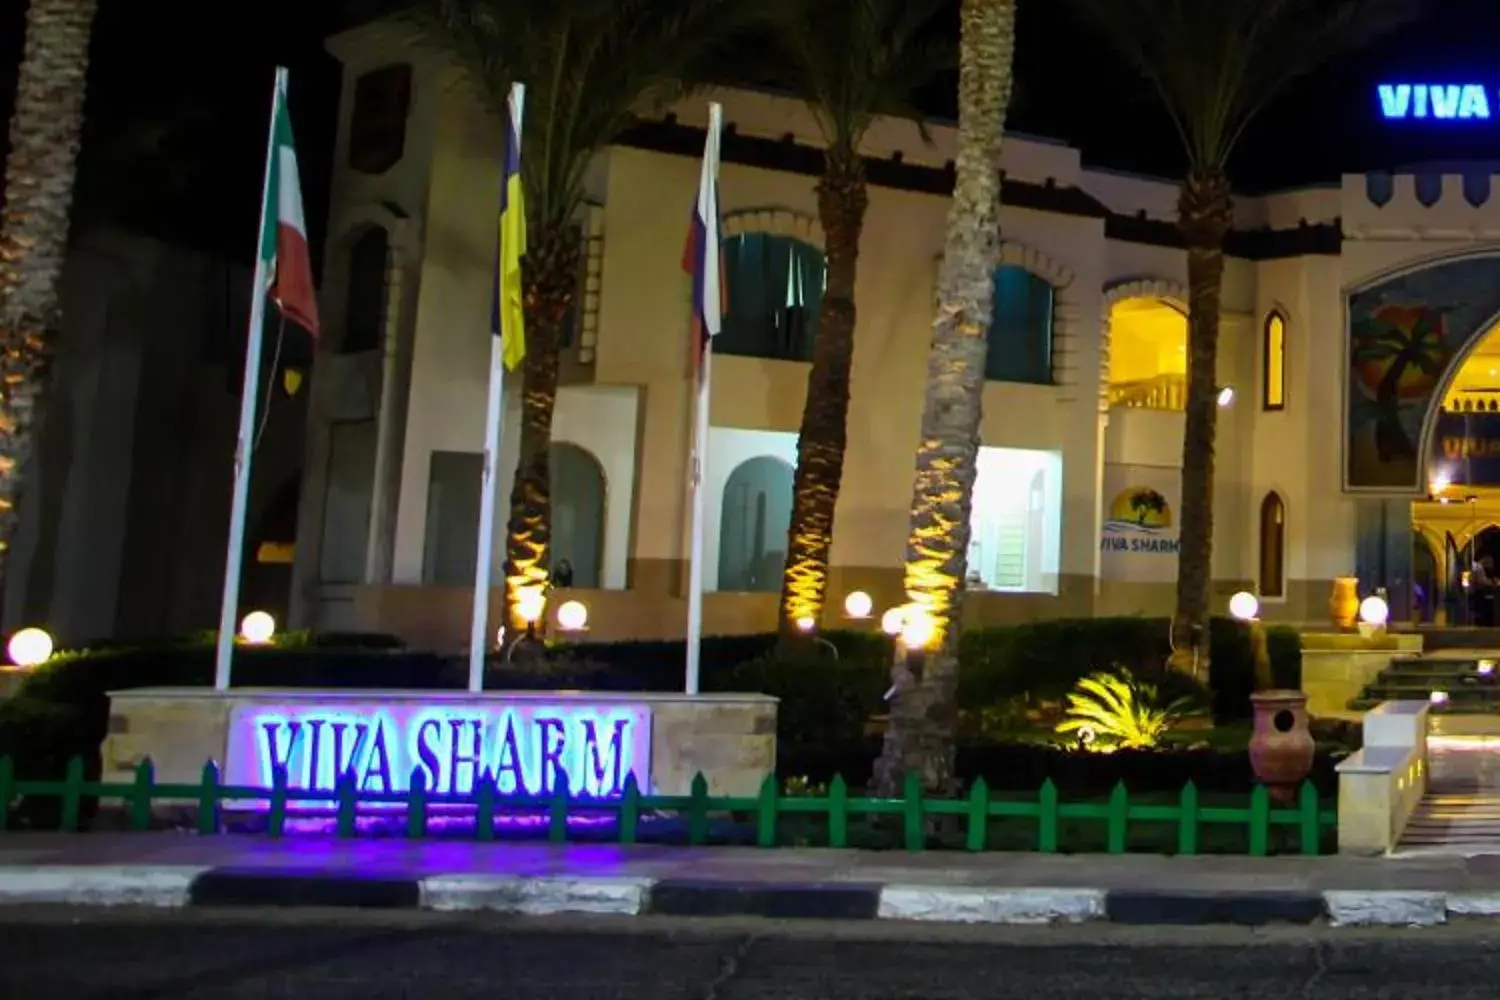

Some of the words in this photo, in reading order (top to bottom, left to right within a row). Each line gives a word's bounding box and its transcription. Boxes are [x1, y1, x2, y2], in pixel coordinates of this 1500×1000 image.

[1377, 83, 1490, 118] VIVA
[262, 717, 394, 797] VIVA
[415, 715, 631, 798] SHARM
